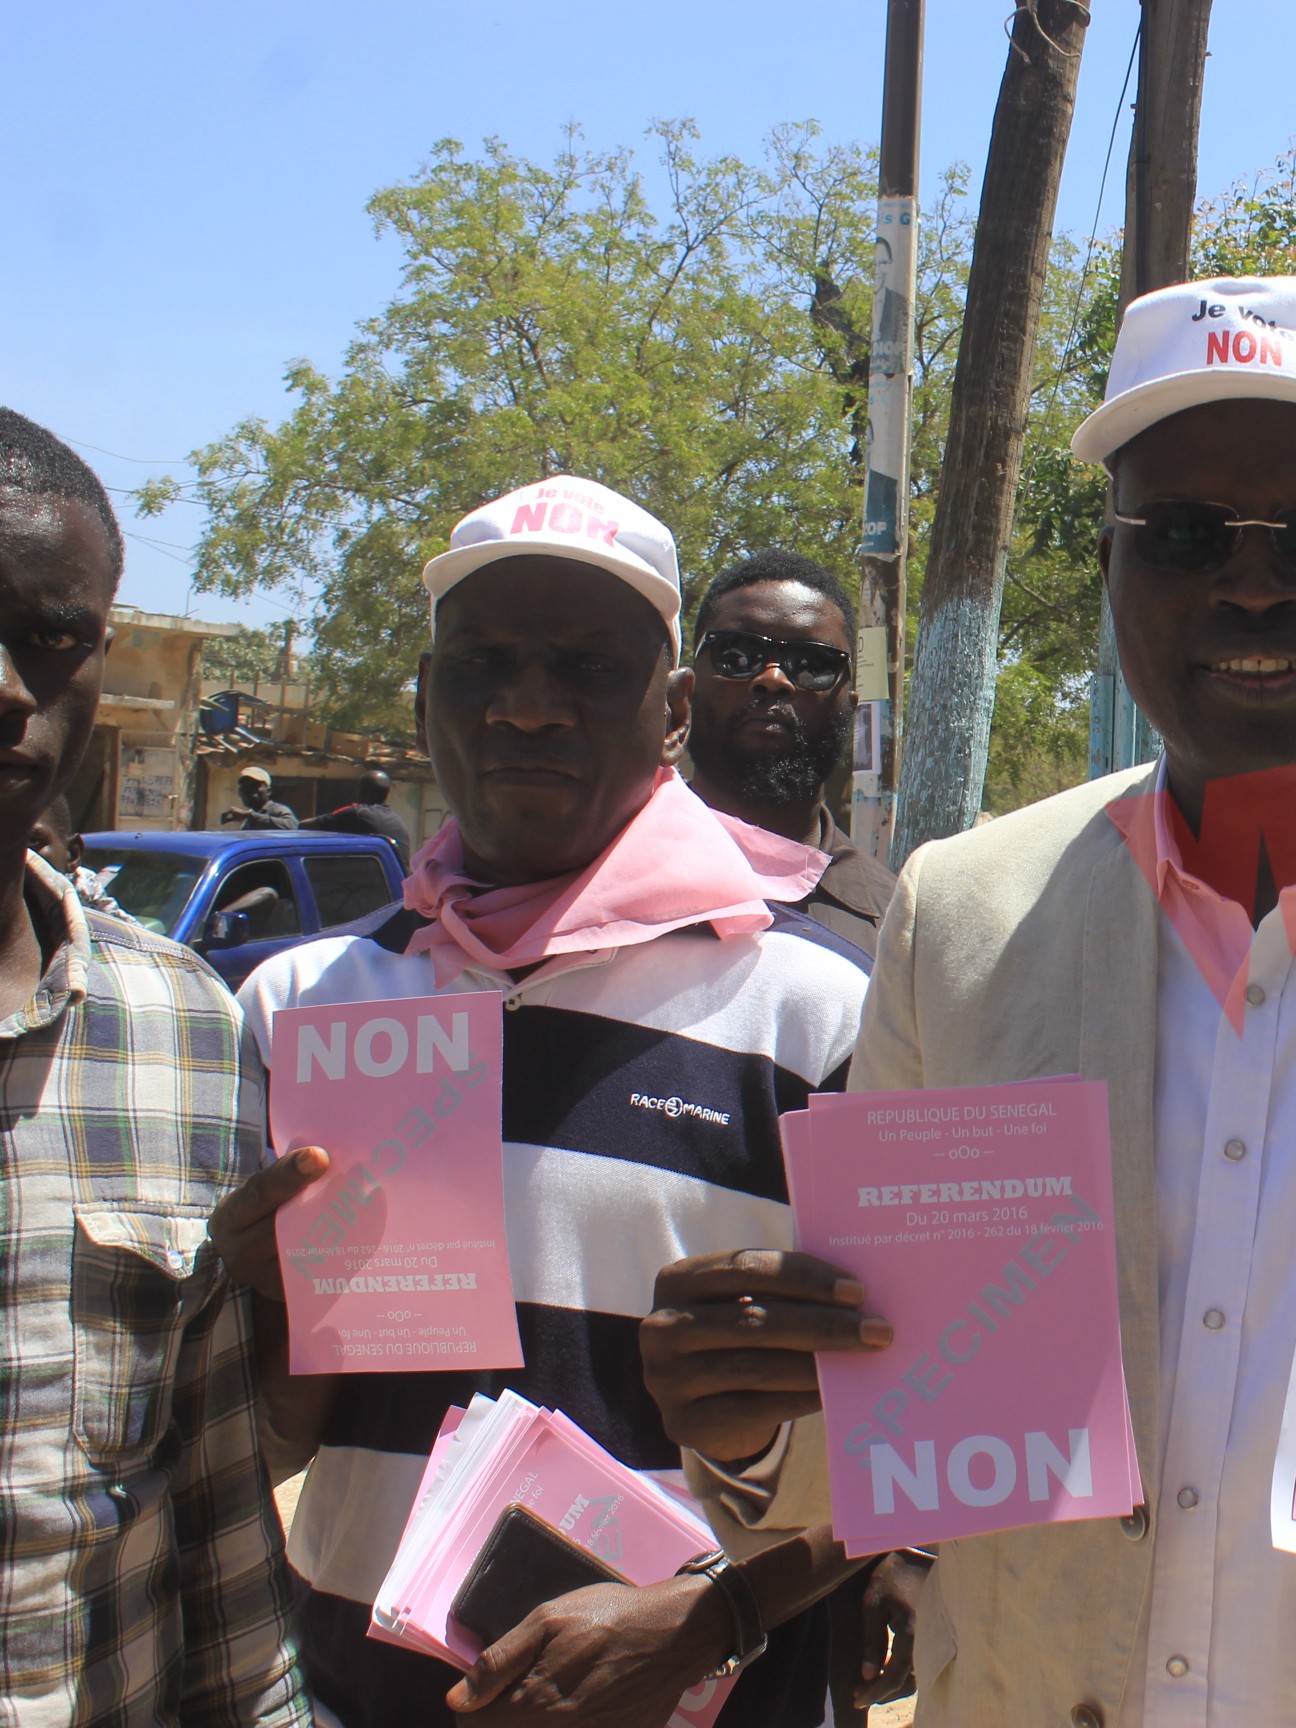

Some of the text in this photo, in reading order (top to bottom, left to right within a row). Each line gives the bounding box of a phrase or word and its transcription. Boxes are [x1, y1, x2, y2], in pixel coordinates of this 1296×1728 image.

[1192, 300, 1225, 322] Je
[1206, 330, 1283, 366] NON
[536, 487, 605, 515] Je vote
[510, 502, 619, 547] NON
[296, 1012, 470, 1083] NON
[630, 1093, 730, 1125] RACE MARINE
[867, 1103, 1056, 1126] REPUBLIQUE DU SENEGAL
[879, 1129, 896, 1142] Un
[899, 1127, 942, 1143] Peuple
[952, 1126, 969, 1139] Un
[972, 1124, 994, 1138] but
[1004, 1124, 1028, 1137] Une
[1030, 1122, 1047, 1135] foi
[949, 1145, 980, 1160] oOo
[289, 1051, 489, 1280] SPECIMEN
[858, 1176, 1073, 1207] REFERENDUM
[906, 1206, 1028, 1226] Du 20 mars 2016
[829, 1233, 872, 1247] Institué
[874, 1235, 892, 1247] par
[895, 1230, 930, 1244] décret
[948, 1228, 975, 1240] 2016
[984, 1226, 1004, 1238] 262
[1007, 1224, 1022, 1236] du
[1025, 1224, 1038, 1236] 18
[1039, 1221, 1074, 1235] février
[1077, 1220, 1104, 1232] 2016
[287, 1248, 305, 1257] 2016
[336, 1246, 344, 1255] 18
[347, 1246, 359, 1255] du
[361, 1245, 376, 1254] 262
[384, 1244, 404, 1253] 2016
[446, 1239, 461, 1249] par
[345, 1256, 437, 1270] Du 20 mars 2016
[312, 1272, 477, 1294] REFERENDUM
[352, 1329, 371, 1339] Une
[379, 1328, 395, 1338] but
[397, 1328, 411, 1338] Un
[418, 1325, 450, 1338] Peuple
[452, 1327, 466, 1337] Un
[844, 1194, 1101, 1469] SPECIMEN
[332, 1341, 477, 1356] REPUBLIQUE DU SENEGAL
[870, 1428, 1093, 1515] NON
[510, 1472, 539, 1504] NEGAL
[531, 1486, 544, 1501] foi
[609, 1494, 624, 1516] 2016
